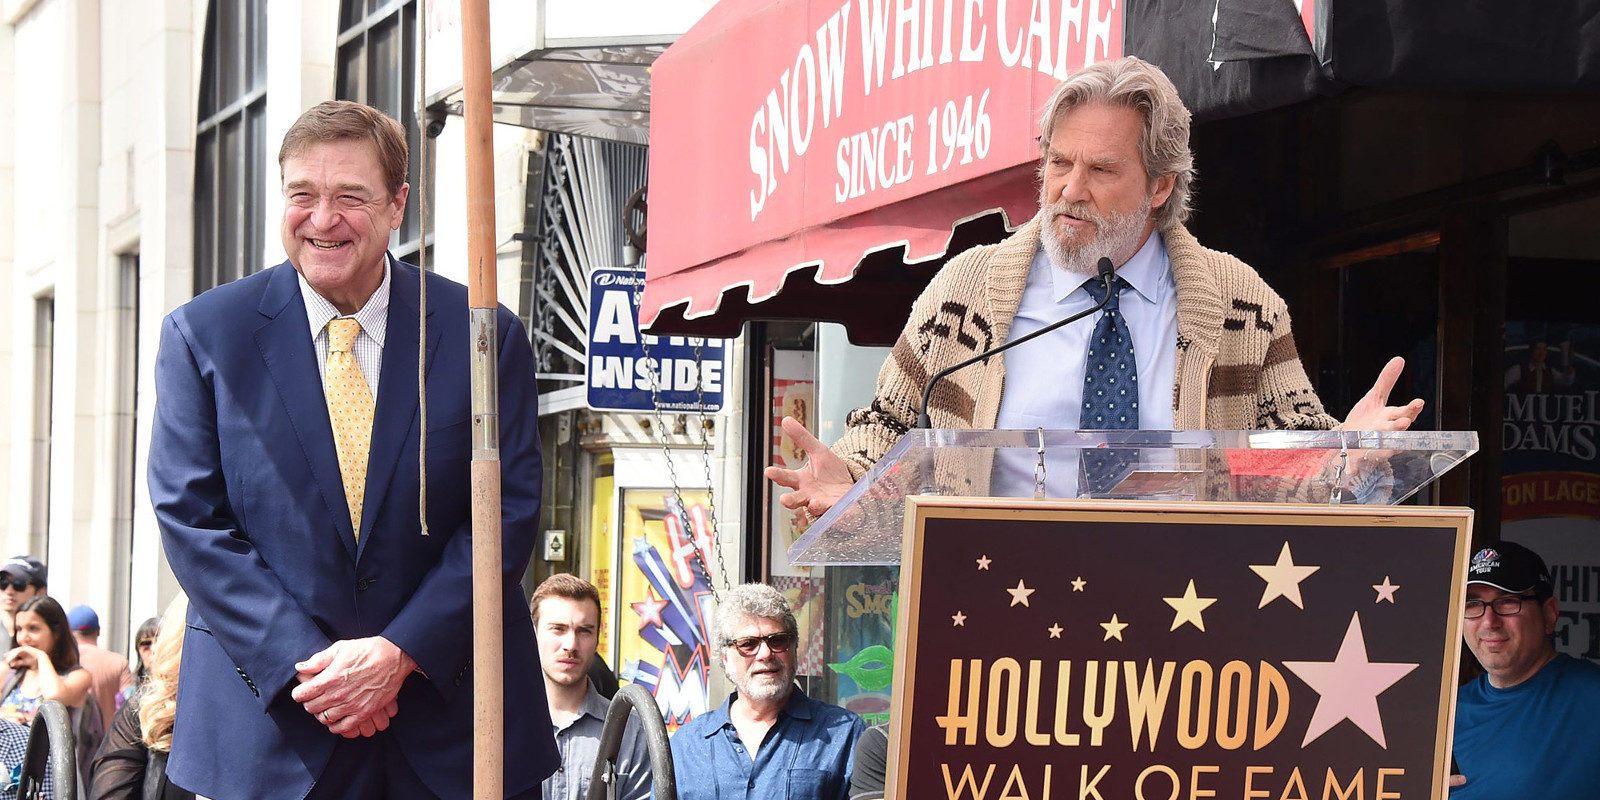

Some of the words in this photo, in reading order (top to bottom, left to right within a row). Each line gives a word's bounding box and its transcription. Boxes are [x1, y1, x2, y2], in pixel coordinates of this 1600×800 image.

[750, 0, 851, 222] SNOW
[858, 0, 987, 96] WHITE
[835, 114, 915, 204] SINCE
[926, 87, 991, 176] 1946
[591, 356, 722, 393] INSIDE
[1502, 422, 1597, 461] DAMS
[1502, 480, 1537, 506] ON
[935, 656, 1290, 753] HOLLYWOOD
[941, 763, 1111, 800] WALK
[1134, 764, 1220, 800] OF
[1243, 766, 1405, 800] FAME
